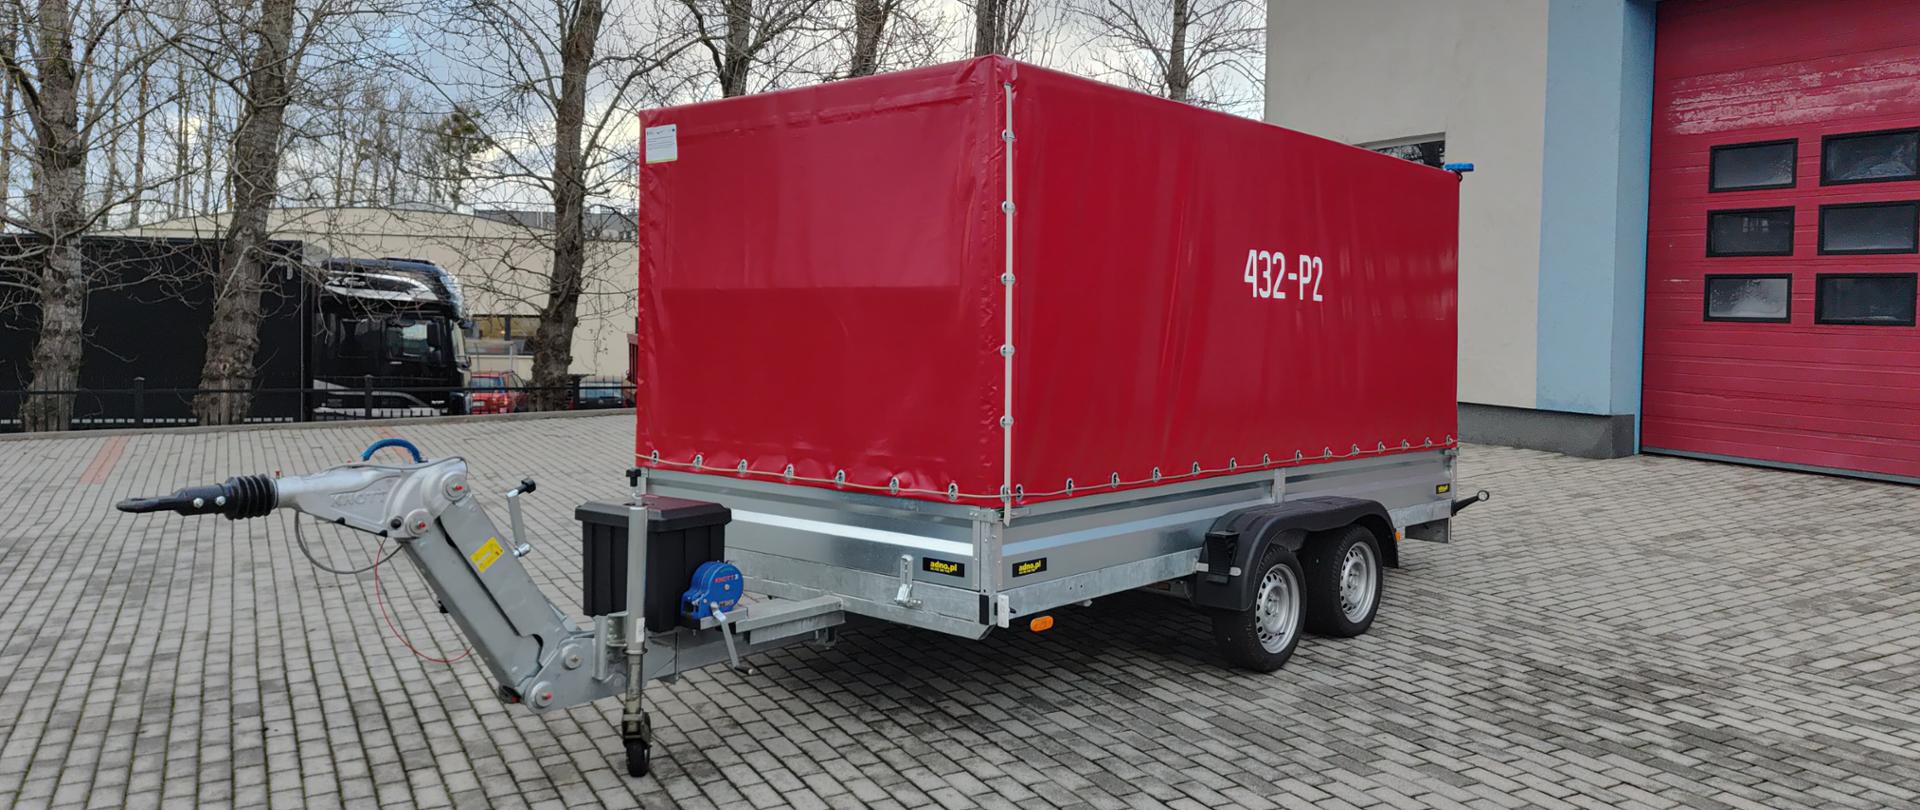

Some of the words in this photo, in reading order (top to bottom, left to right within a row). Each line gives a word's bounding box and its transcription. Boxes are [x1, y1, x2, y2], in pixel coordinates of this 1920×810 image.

[1244, 249, 1323, 302] 432-P2
[930, 560, 957, 572] adno.pl
[1019, 560, 1041, 572] adno.pl
